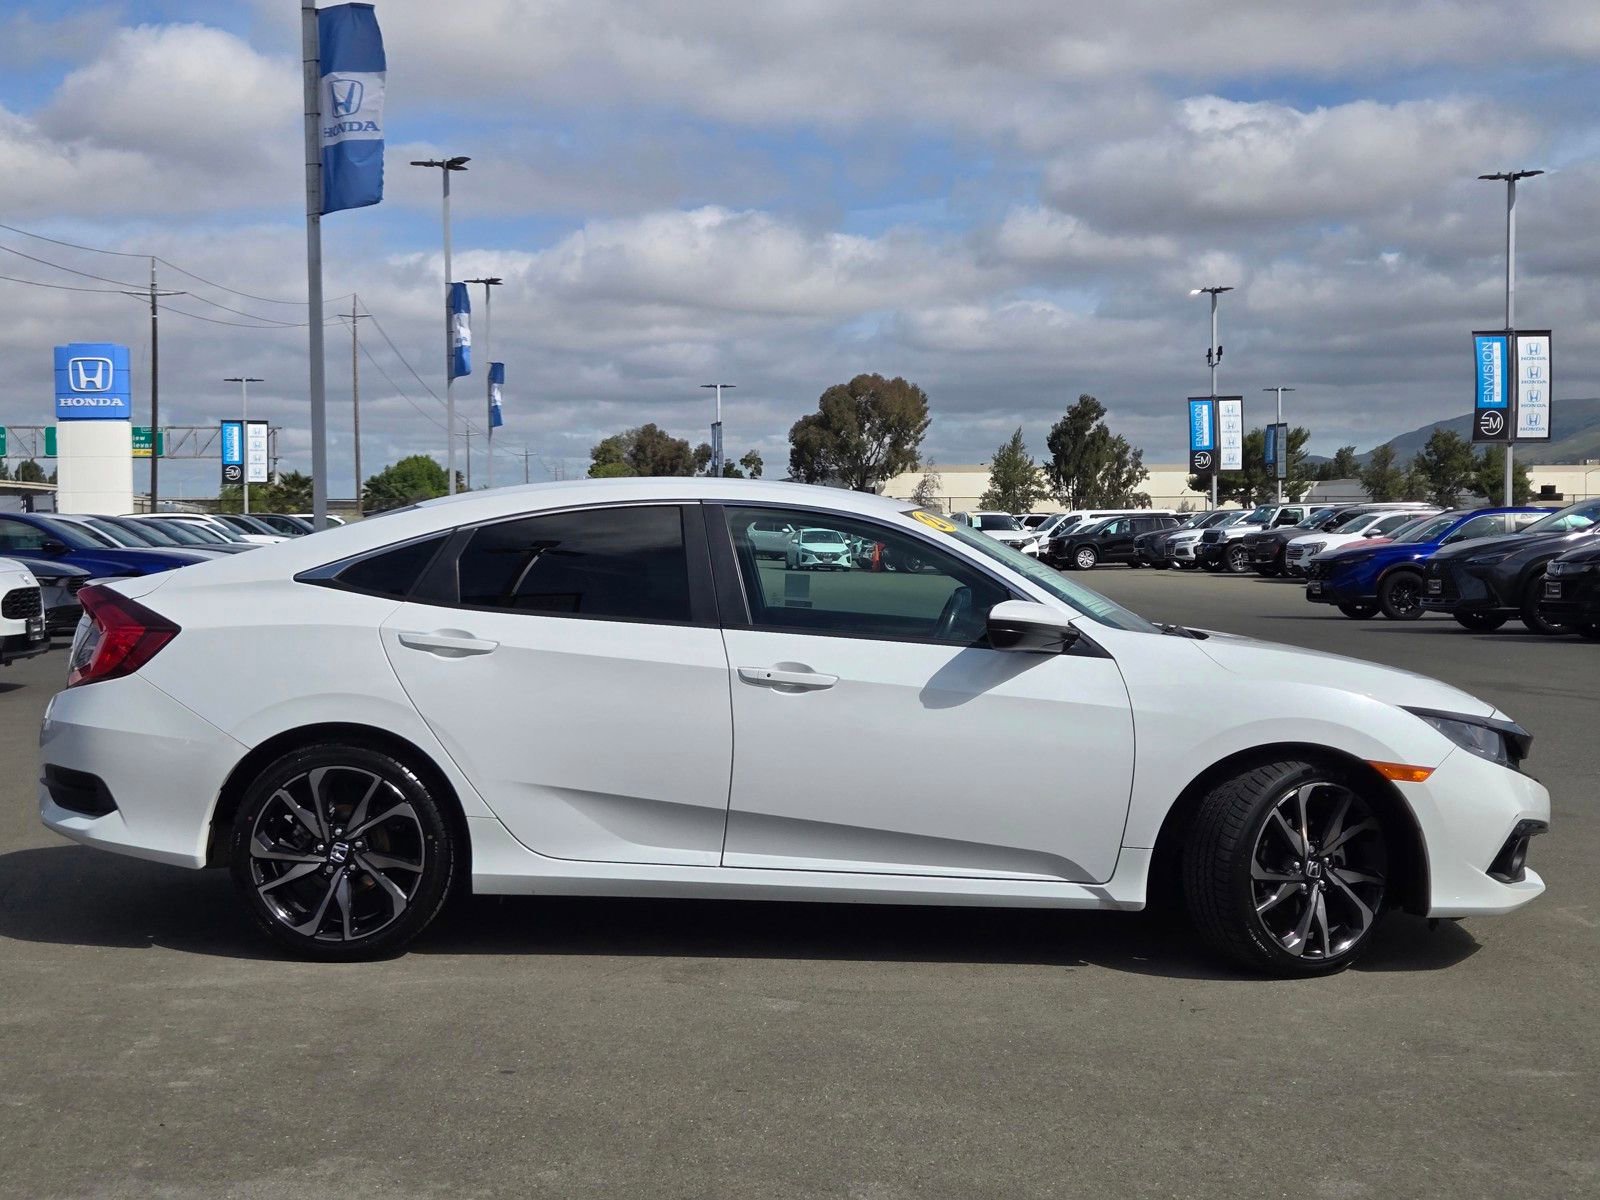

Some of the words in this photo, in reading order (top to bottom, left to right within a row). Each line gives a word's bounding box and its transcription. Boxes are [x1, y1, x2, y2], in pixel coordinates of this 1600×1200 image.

[323, 121, 380, 137] HONDA
[1482, 341, 1494, 403] ENVISION
[58, 398, 125, 407] HONDA
[1195, 404, 1203, 447] ENVISION
